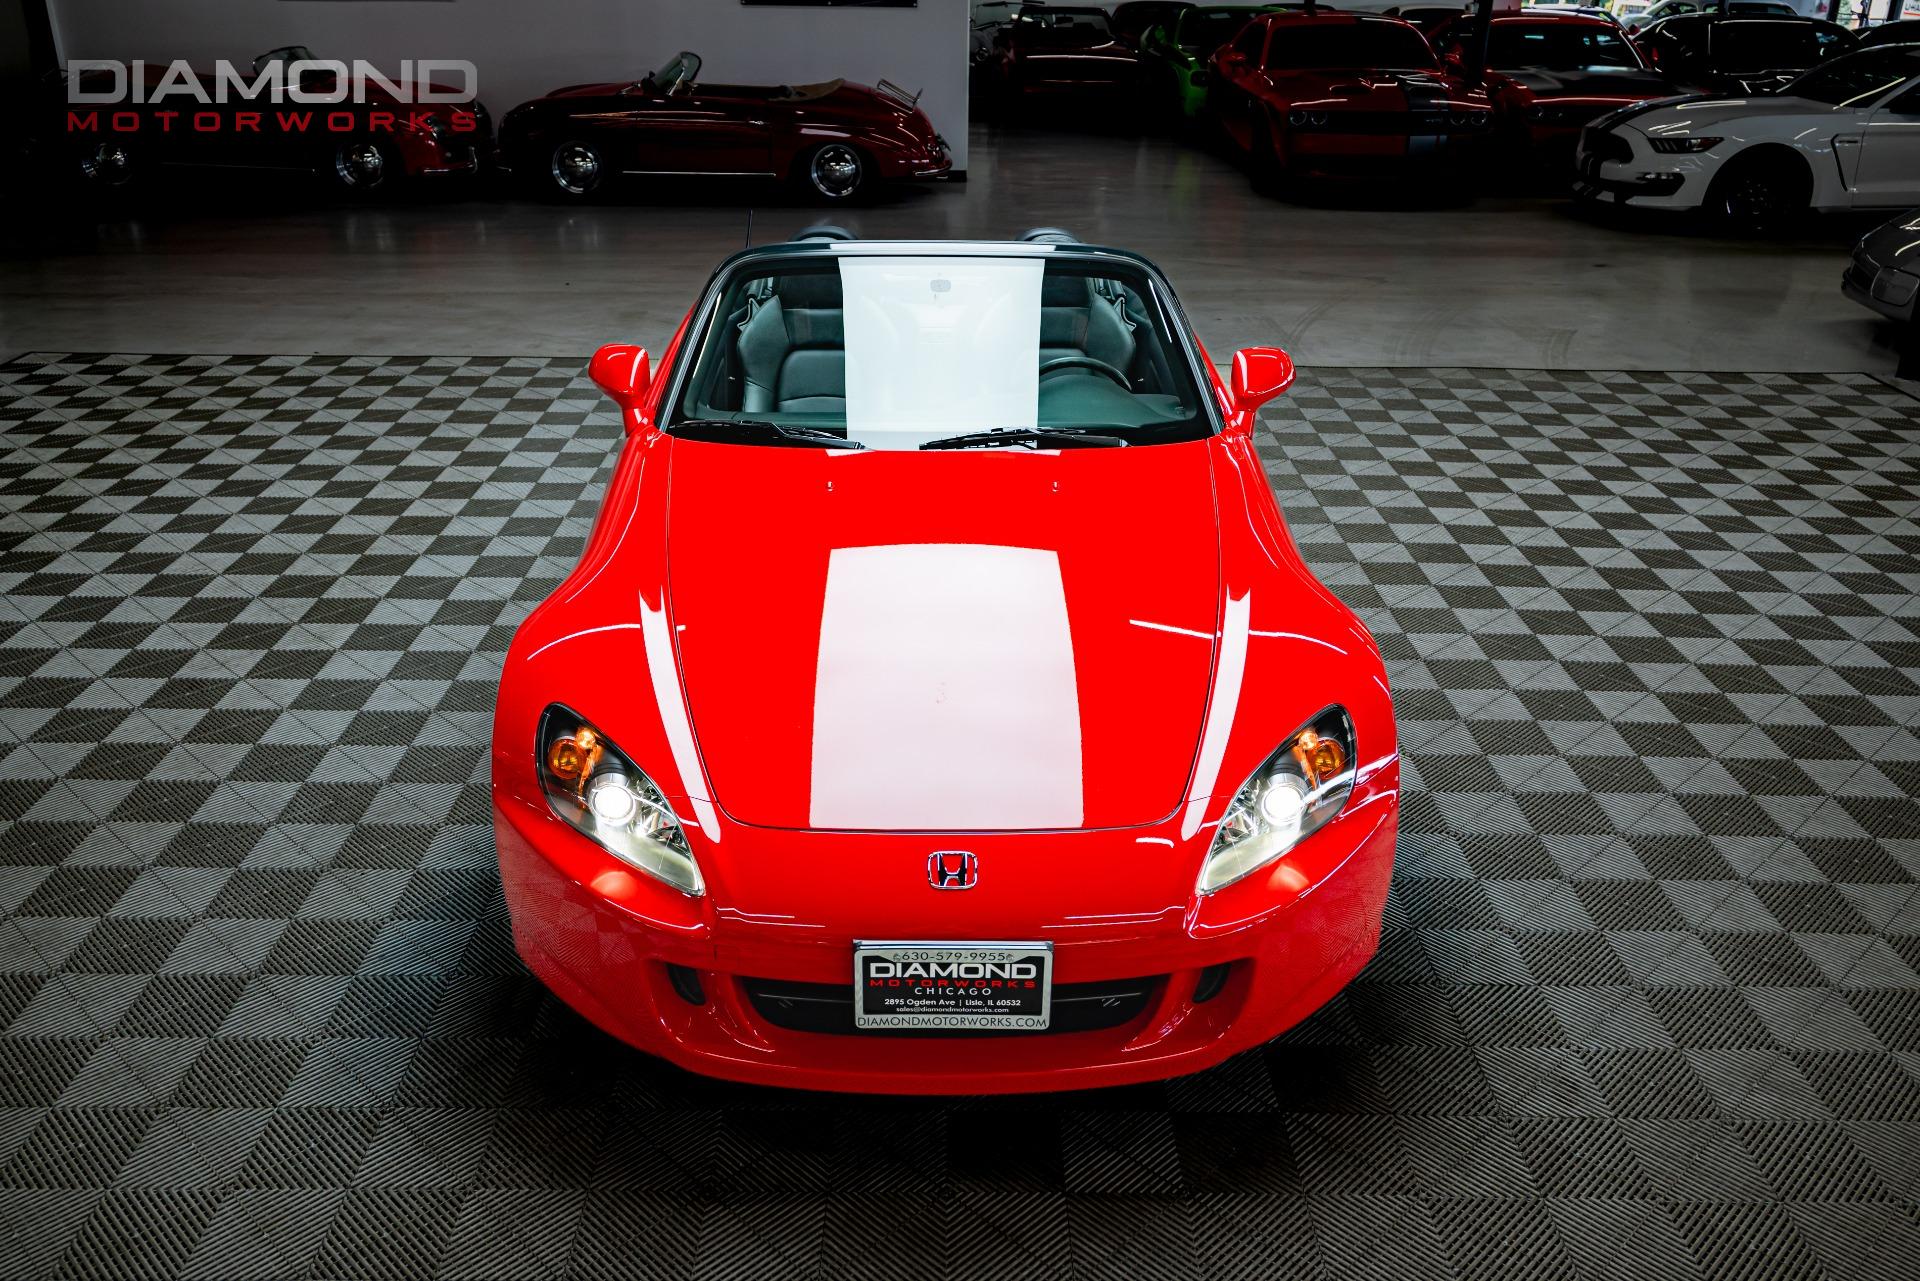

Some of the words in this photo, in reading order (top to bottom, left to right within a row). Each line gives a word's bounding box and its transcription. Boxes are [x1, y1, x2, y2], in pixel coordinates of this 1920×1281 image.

[902, 952, 1005, 960] 630-579-9955
[870, 963, 1036, 979] DIAMOND
[870, 979, 1036, 988] MOTORWORKS
[914, 987, 991, 995] CHICAGO
[884, 998, 904, 1006] 2895
[906, 998, 936, 1007] Ogden
[965, 999, 985, 1007] Lisle,
[857, 1016, 1047, 1028] DIAMONDMOTORWORKS.COM
